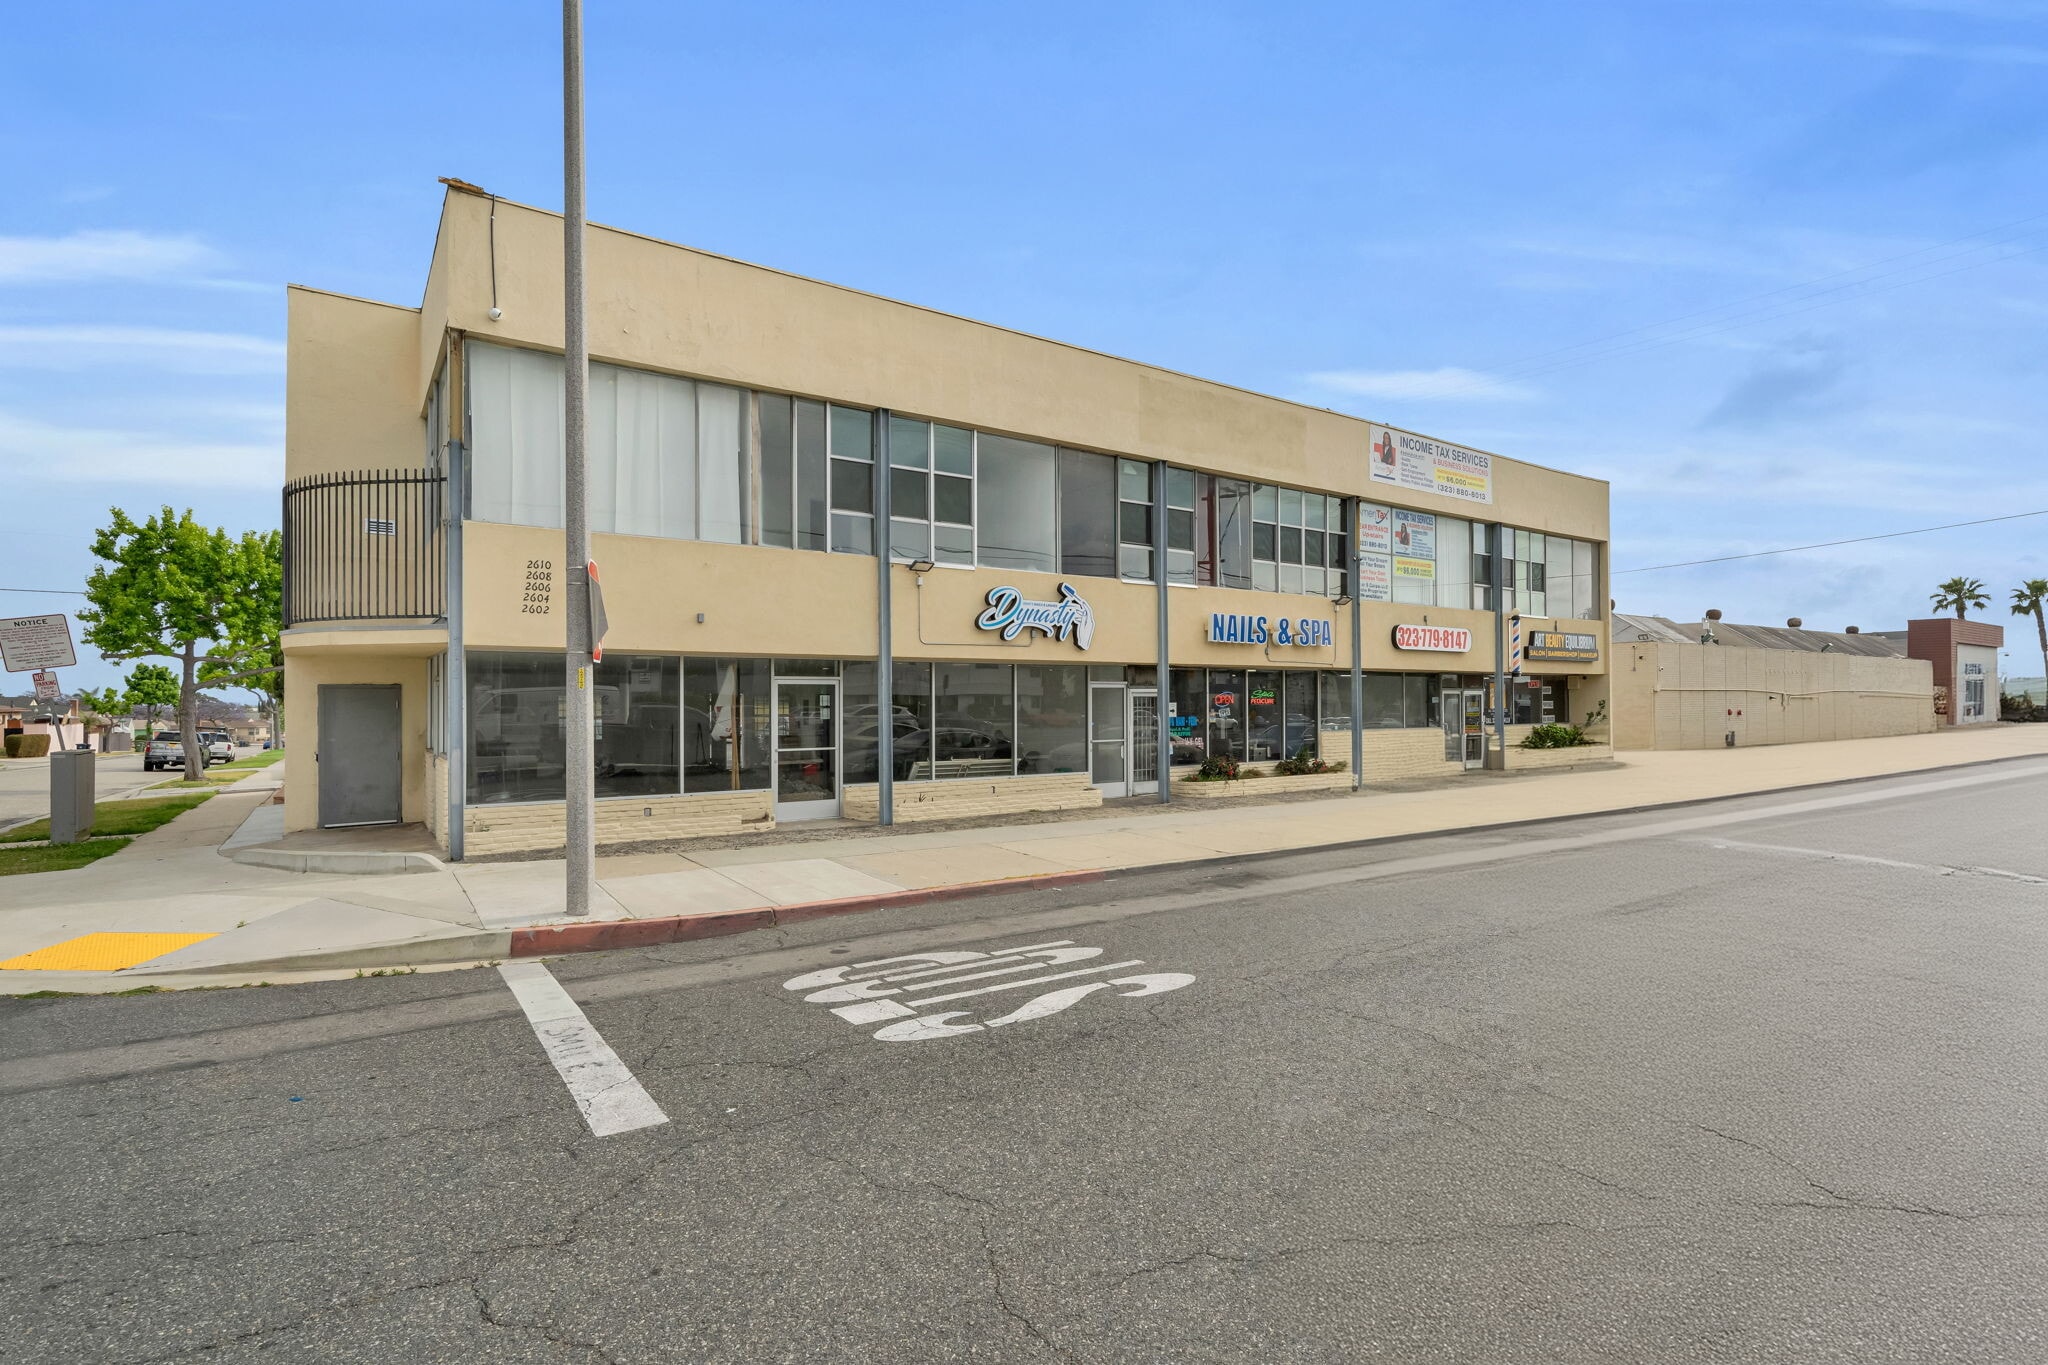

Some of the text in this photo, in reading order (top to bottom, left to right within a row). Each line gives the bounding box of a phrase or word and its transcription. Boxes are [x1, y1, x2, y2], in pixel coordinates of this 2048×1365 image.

[1400, 436, 1432, 455] INCOME
[1435, 445, 1450, 458] TAX
[1452, 449, 1488, 468] SERVICES
[1438, 459, 1462, 470] BUSINESS
[1462, 464, 1488, 477] SOLUTIONS
[1438, 484, 1455, 494] (323)
[1395, 511, 1409, 522] INCOME
[1417, 514, 1433, 526] SERVICES
[527, 560, 552, 569] 2610
[526, 571, 552, 581] 2608
[525, 582, 551, 592] 2606
[523, 593, 550, 603] 2604
[522, 604, 550, 614] 2602
[979, 586, 1076, 641] Dynasty
[14, 618, 48, 627] NOTICE
[1210, 613, 1332, 646] NAILS & SPA
[1534, 633, 1595, 650] ART BEAUTY EQUILIBRIUM
[1214, 693, 1235, 705] OPEN
[1250, 690, 1275, 698] Spa
